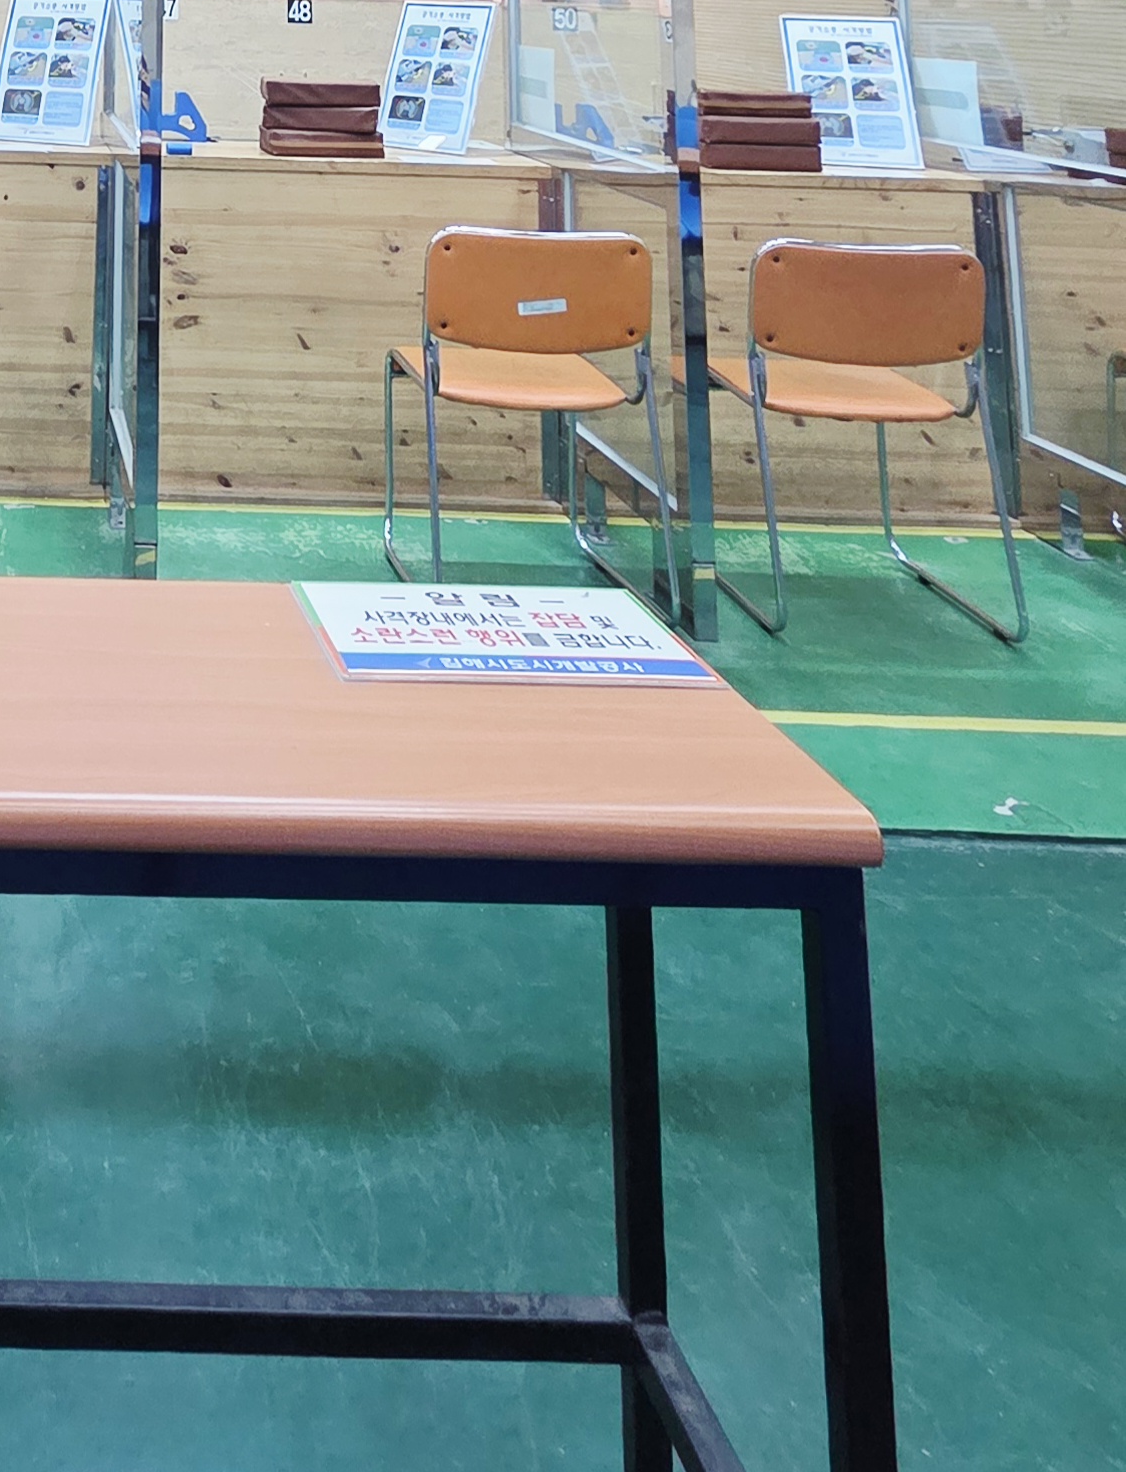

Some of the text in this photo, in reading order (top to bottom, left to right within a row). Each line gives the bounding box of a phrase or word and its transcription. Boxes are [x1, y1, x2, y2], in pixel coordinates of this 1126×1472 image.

[288, 0, 311, 22] 48
[554, 7, 577, 30] 50
[364, 610, 619, 630] 사격장내에서는 잡담 및
[351, 627, 462, 645] 소란스런
[553, 632, 662, 651] 금합니다.
